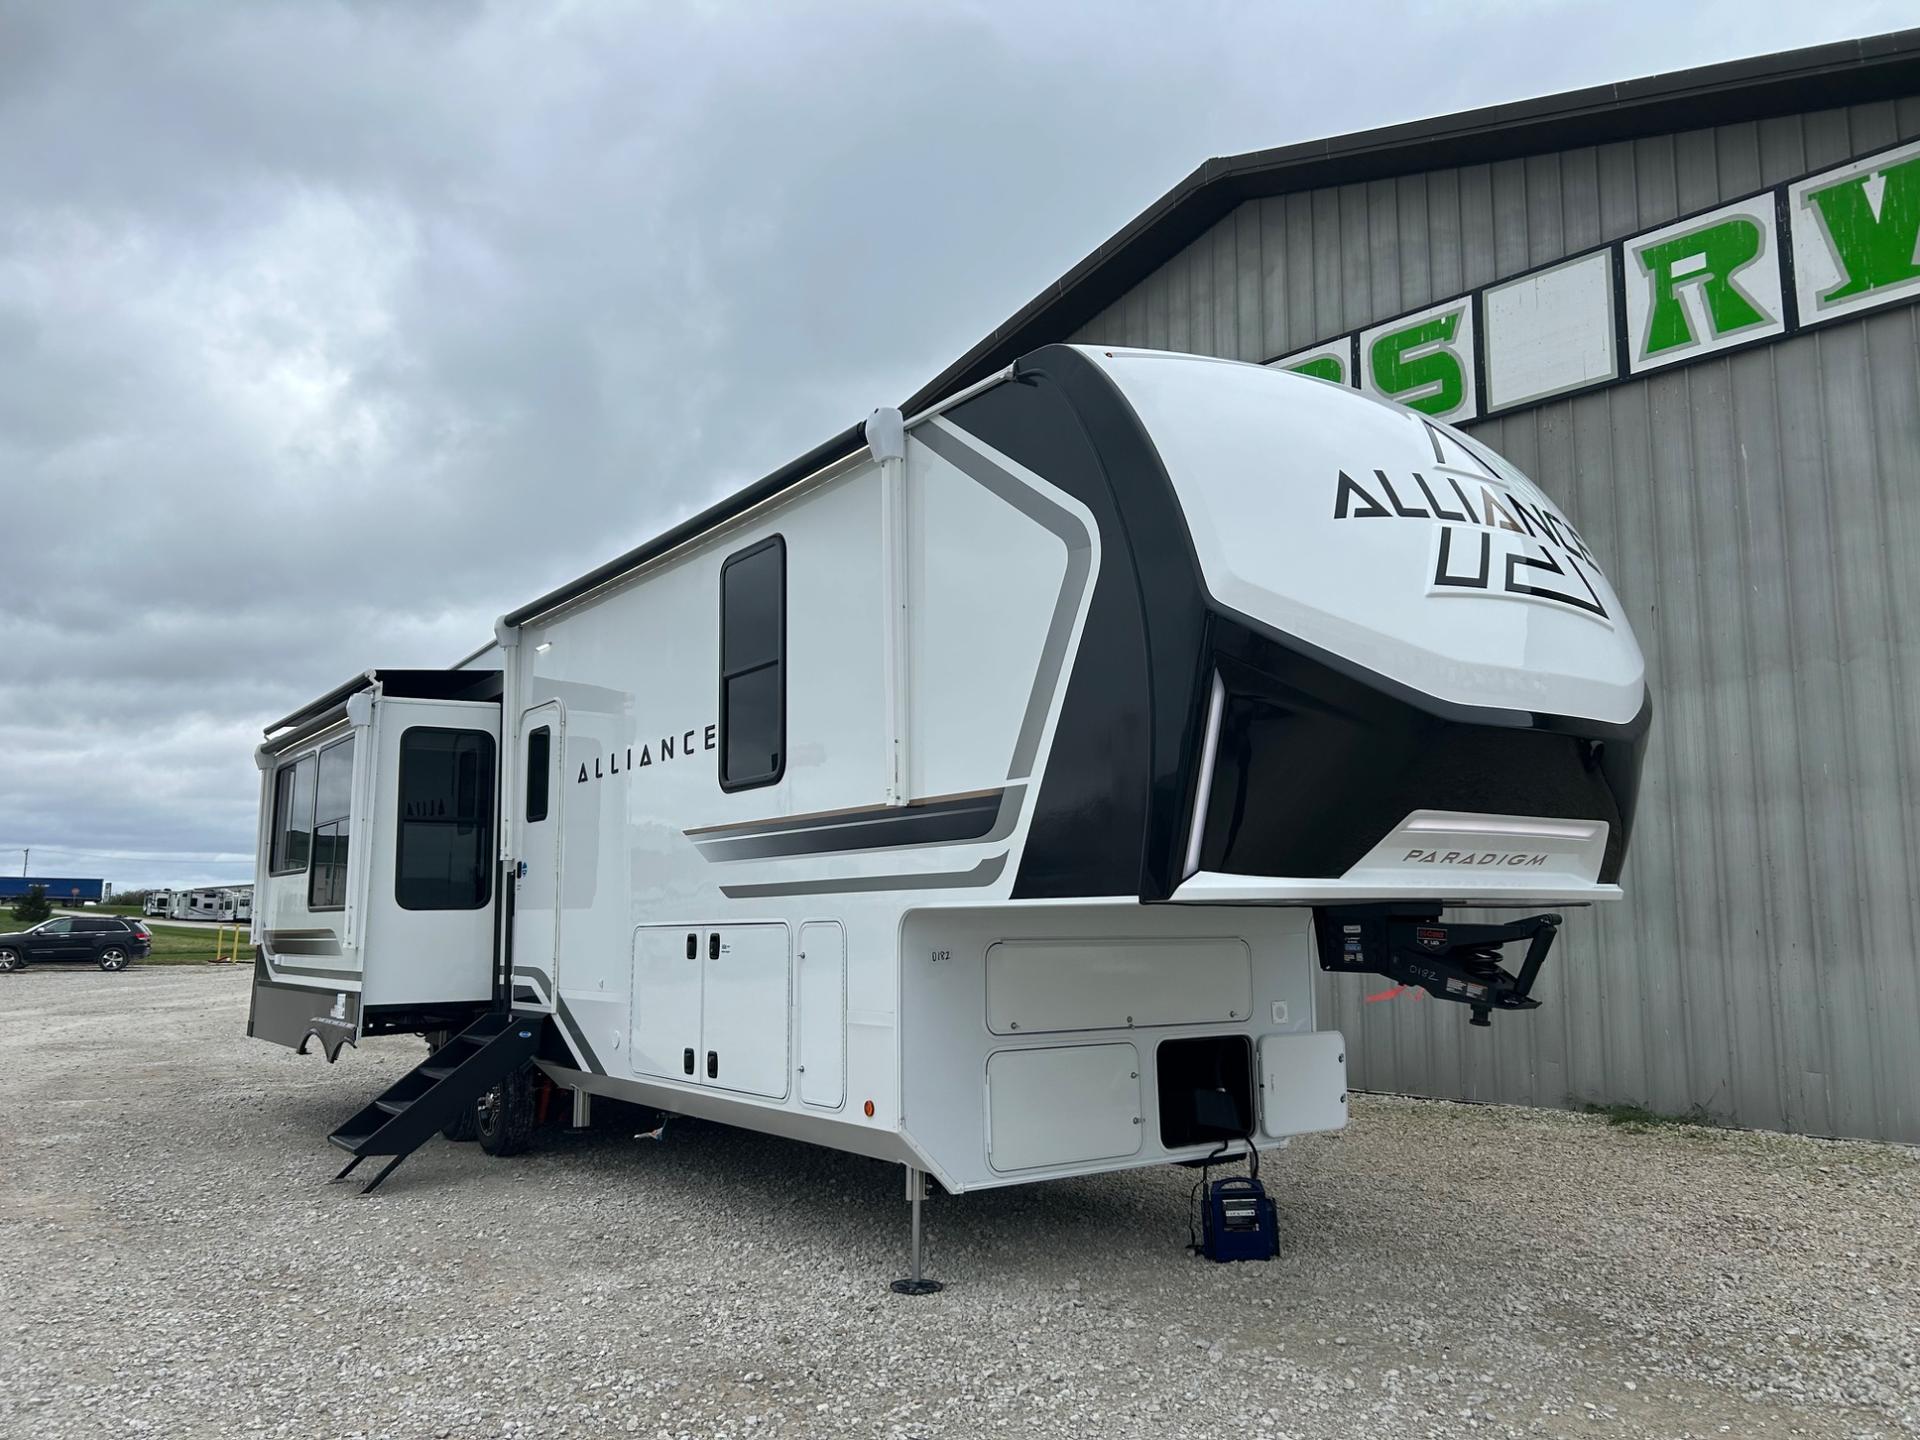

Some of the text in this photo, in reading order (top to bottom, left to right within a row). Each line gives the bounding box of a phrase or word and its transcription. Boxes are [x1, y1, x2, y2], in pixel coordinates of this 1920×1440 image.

[1638, 152, 1920, 361] RV
[578, 724, 716, 783] ALLIANCE
[1402, 849, 1549, 866] PARADIGM
